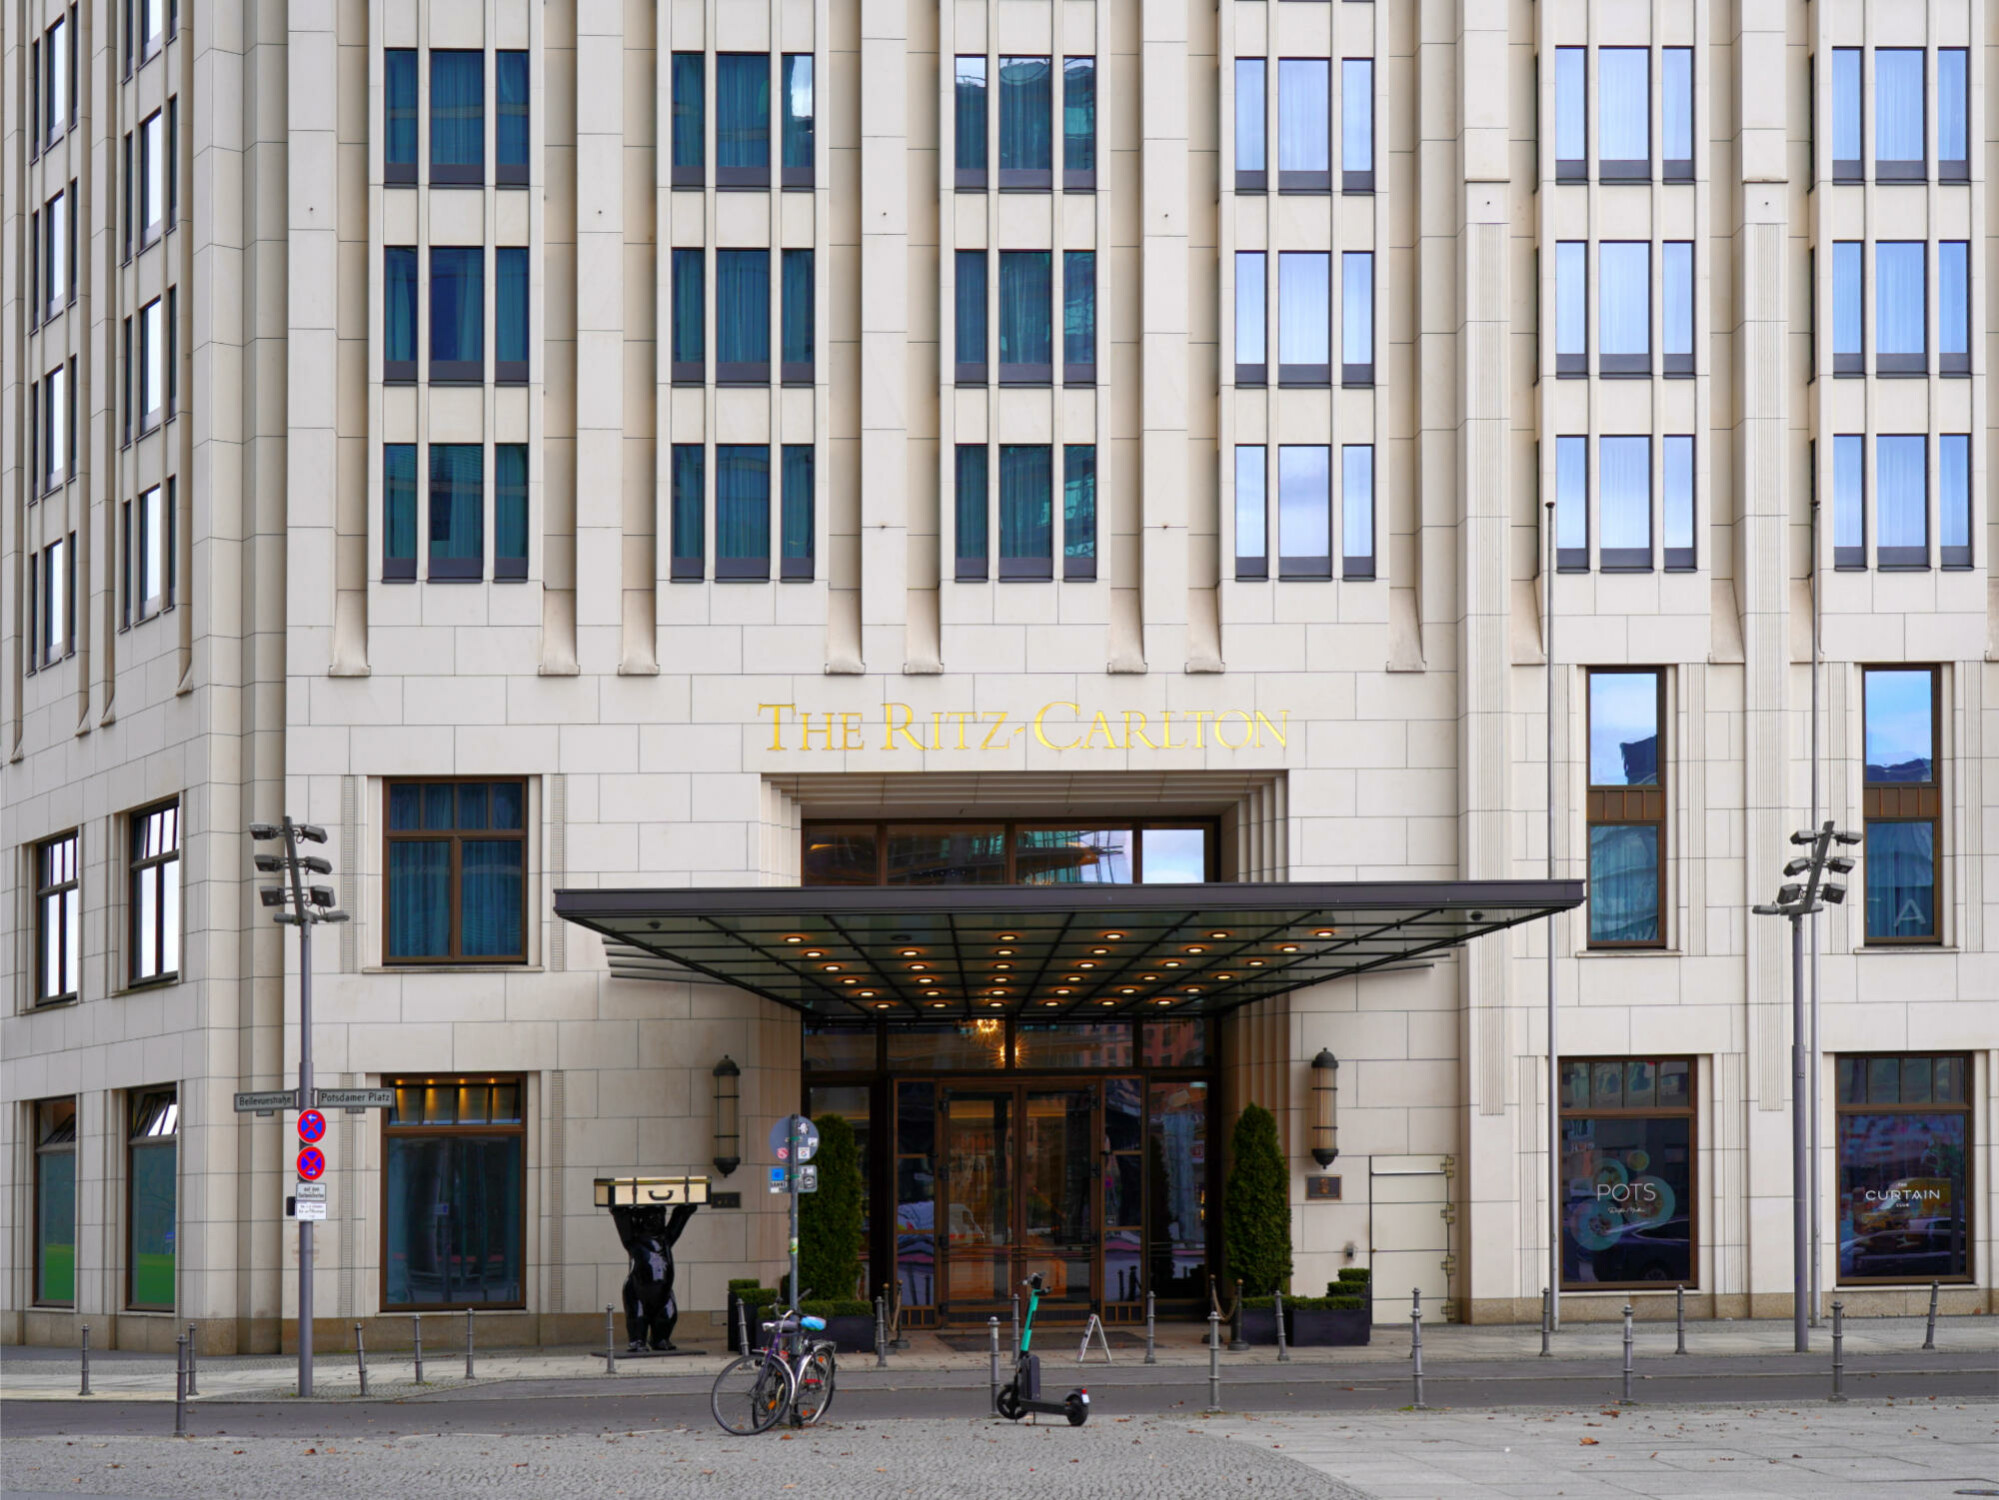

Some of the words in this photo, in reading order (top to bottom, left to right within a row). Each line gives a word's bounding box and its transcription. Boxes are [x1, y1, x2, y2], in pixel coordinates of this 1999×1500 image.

[757, 702, 864, 752] THE
[321, 1092, 365, 1103] Potsdamer
[368, 1091, 390, 1102] Platz
[1597, 1183, 1656, 1201] POTS
[1865, 1189, 1940, 1201] CURTAIN
